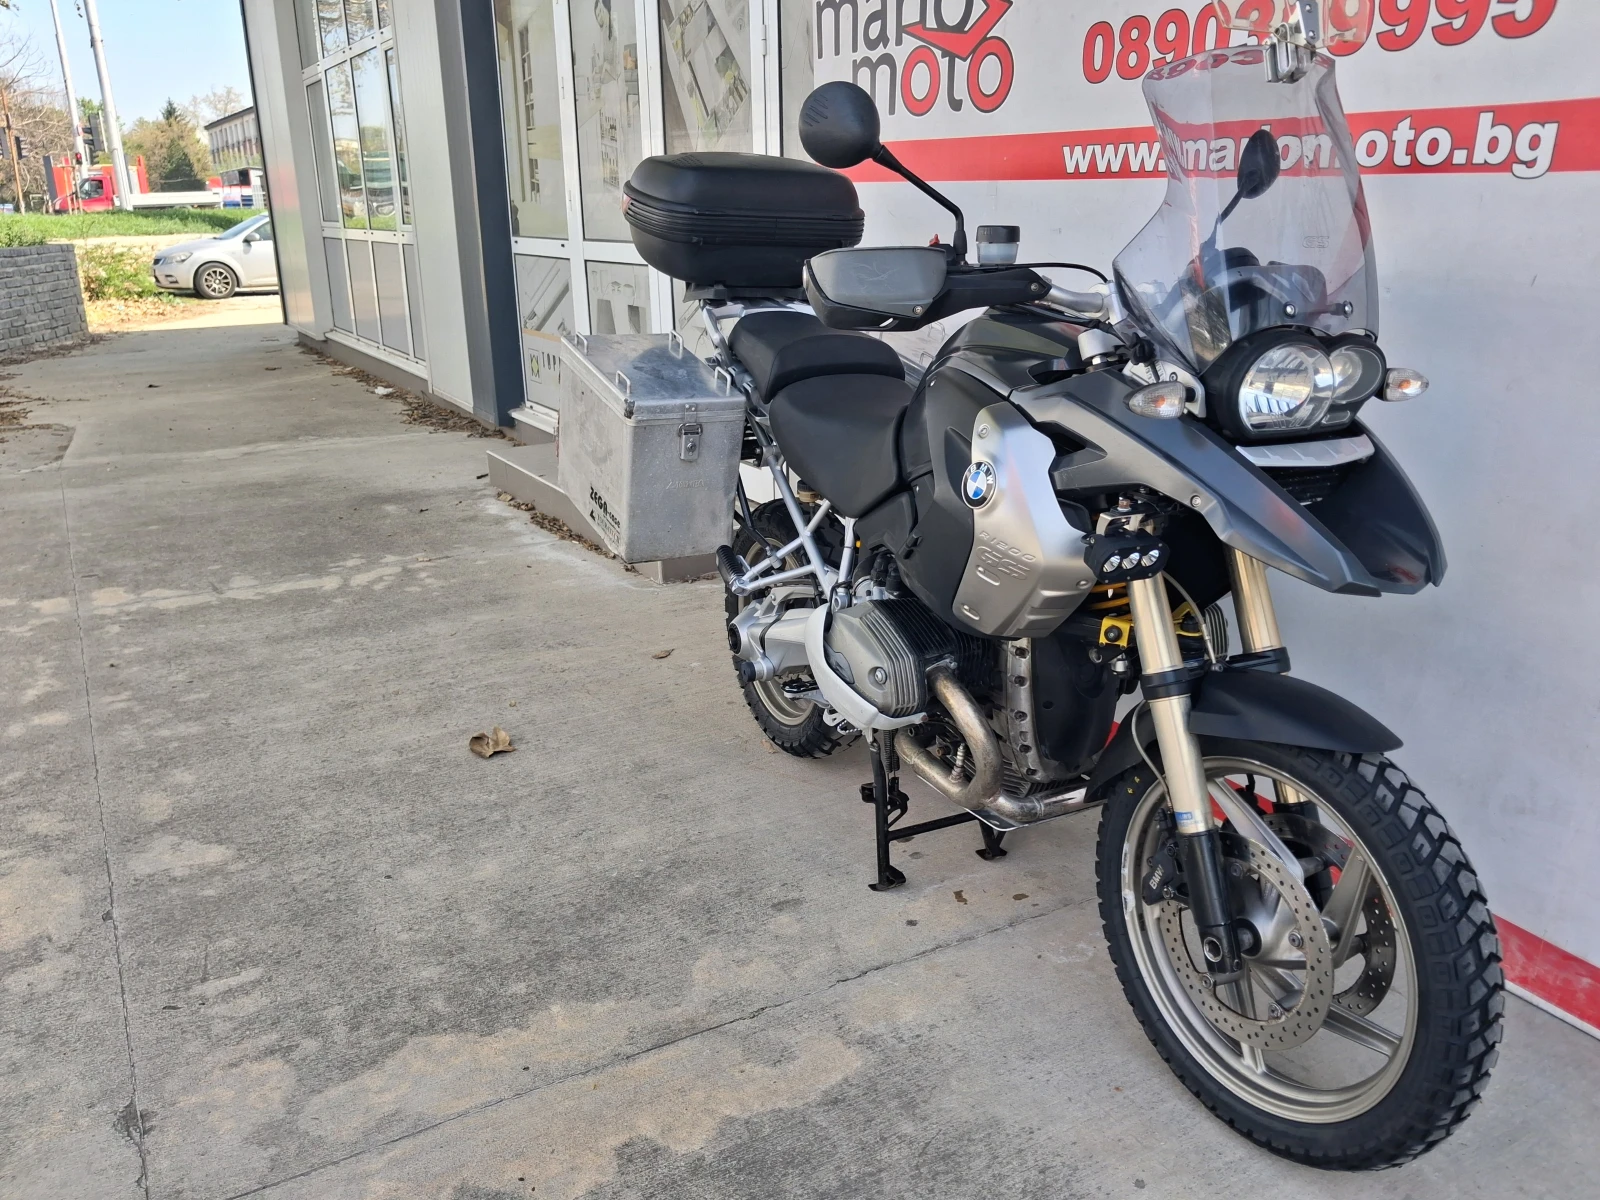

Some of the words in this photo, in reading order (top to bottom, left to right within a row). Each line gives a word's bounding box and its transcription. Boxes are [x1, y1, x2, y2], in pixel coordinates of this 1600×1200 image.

[1082, 0, 1559, 84] 089039995
[852, 36, 1014, 117] moto
[1062, 111, 1560, 180] www.maomoto.bg
[976, 545, 1031, 580] GS
[979, 530, 1036, 563] R1200
[1149, 863, 1165, 890] BMW
